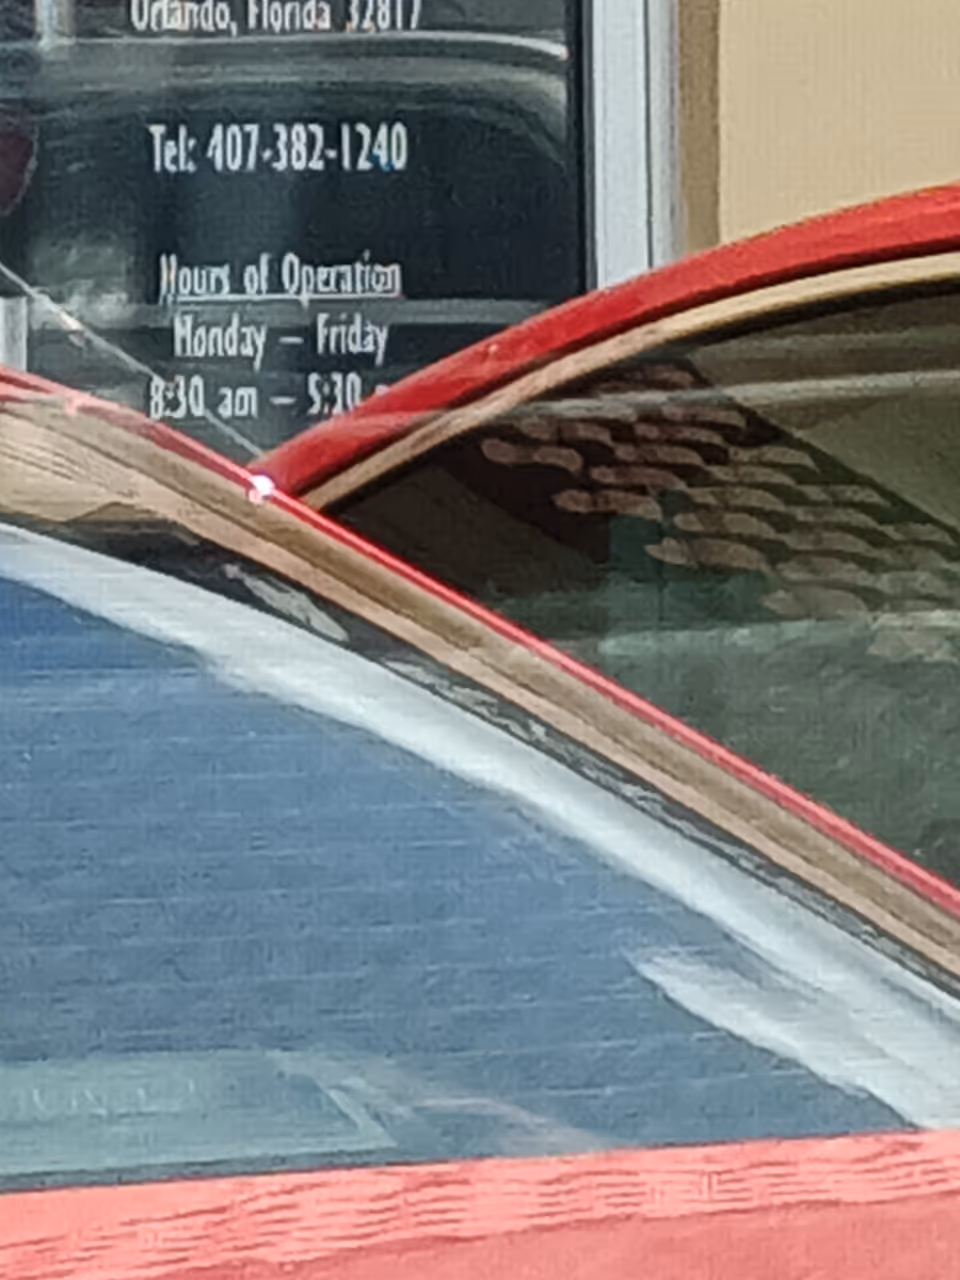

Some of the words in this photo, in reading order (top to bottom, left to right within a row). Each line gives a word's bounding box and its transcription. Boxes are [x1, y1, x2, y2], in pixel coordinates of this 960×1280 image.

[148, 124, 197, 173] Tel:
[207, 121, 408, 172] 407-382-1240
[159, 253, 231, 298] Hours
[243, 251, 271, 297] of
[281, 250, 403, 308] Operation
[173, 312, 268, 372] Monday
[316, 312, 390, 366] Friday
[149, 374, 205, 420] 8:30
[217, 385, 258, 419] am
[307, 371, 362, 415] 5:30
